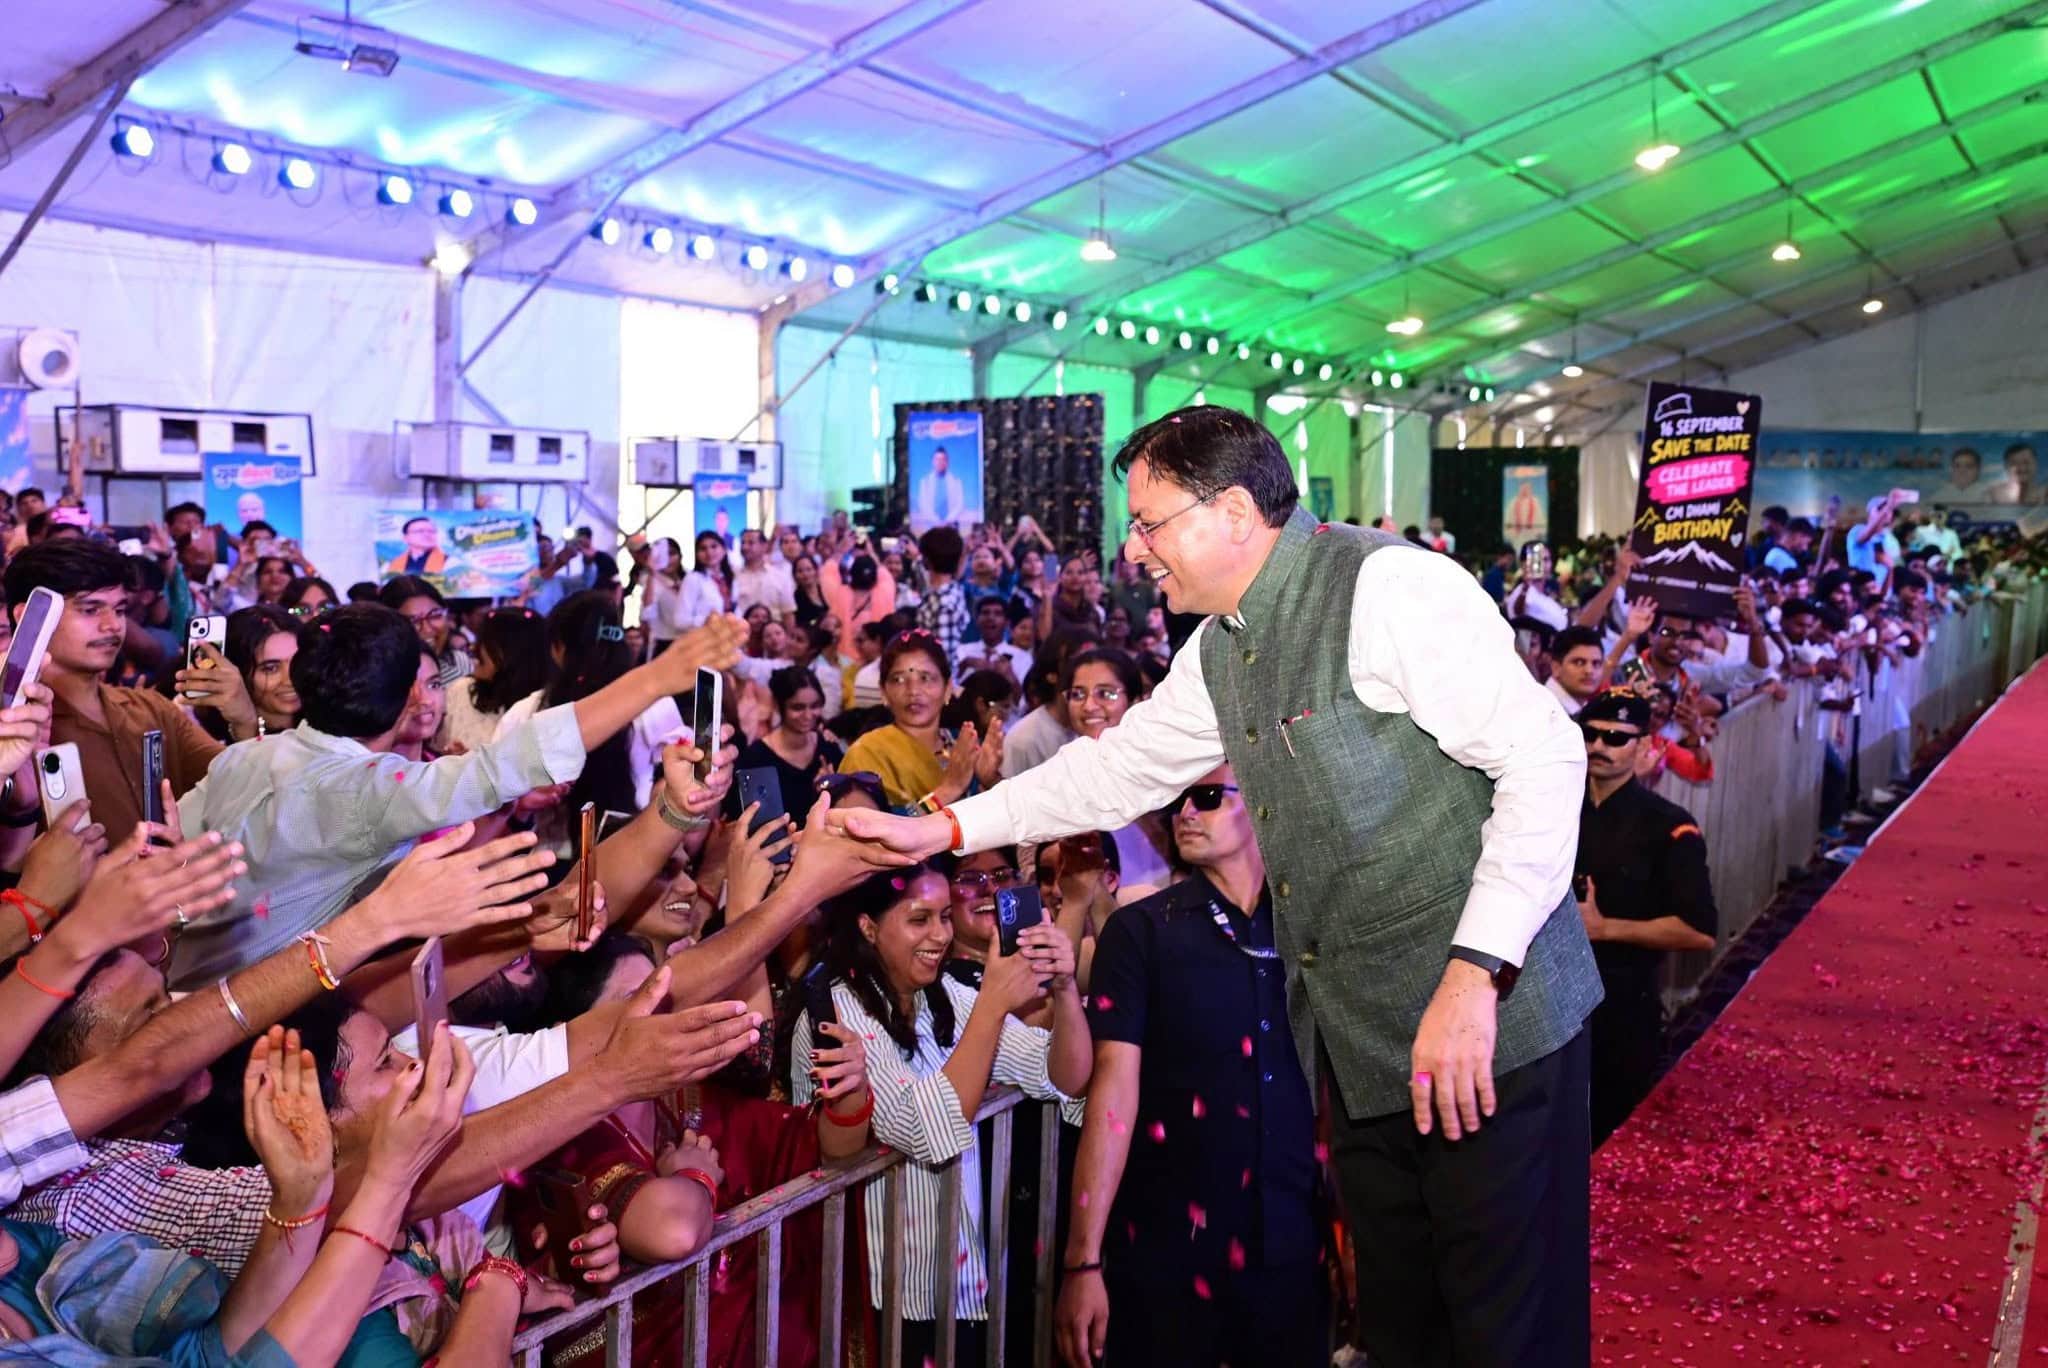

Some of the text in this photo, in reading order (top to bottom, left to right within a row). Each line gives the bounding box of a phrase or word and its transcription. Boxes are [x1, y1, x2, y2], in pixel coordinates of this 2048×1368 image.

[1676, 416, 1743, 436] SEPTEMBER
[1649, 434, 1750, 464] SAVE THE DATE
[1659, 460, 1732, 483] CELEBRATE
[1666, 477, 1734, 497] THE LEADER
[1665, 501, 1720, 521] CM DHAMI
[1654, 518, 1732, 544] BIRTHDAY
